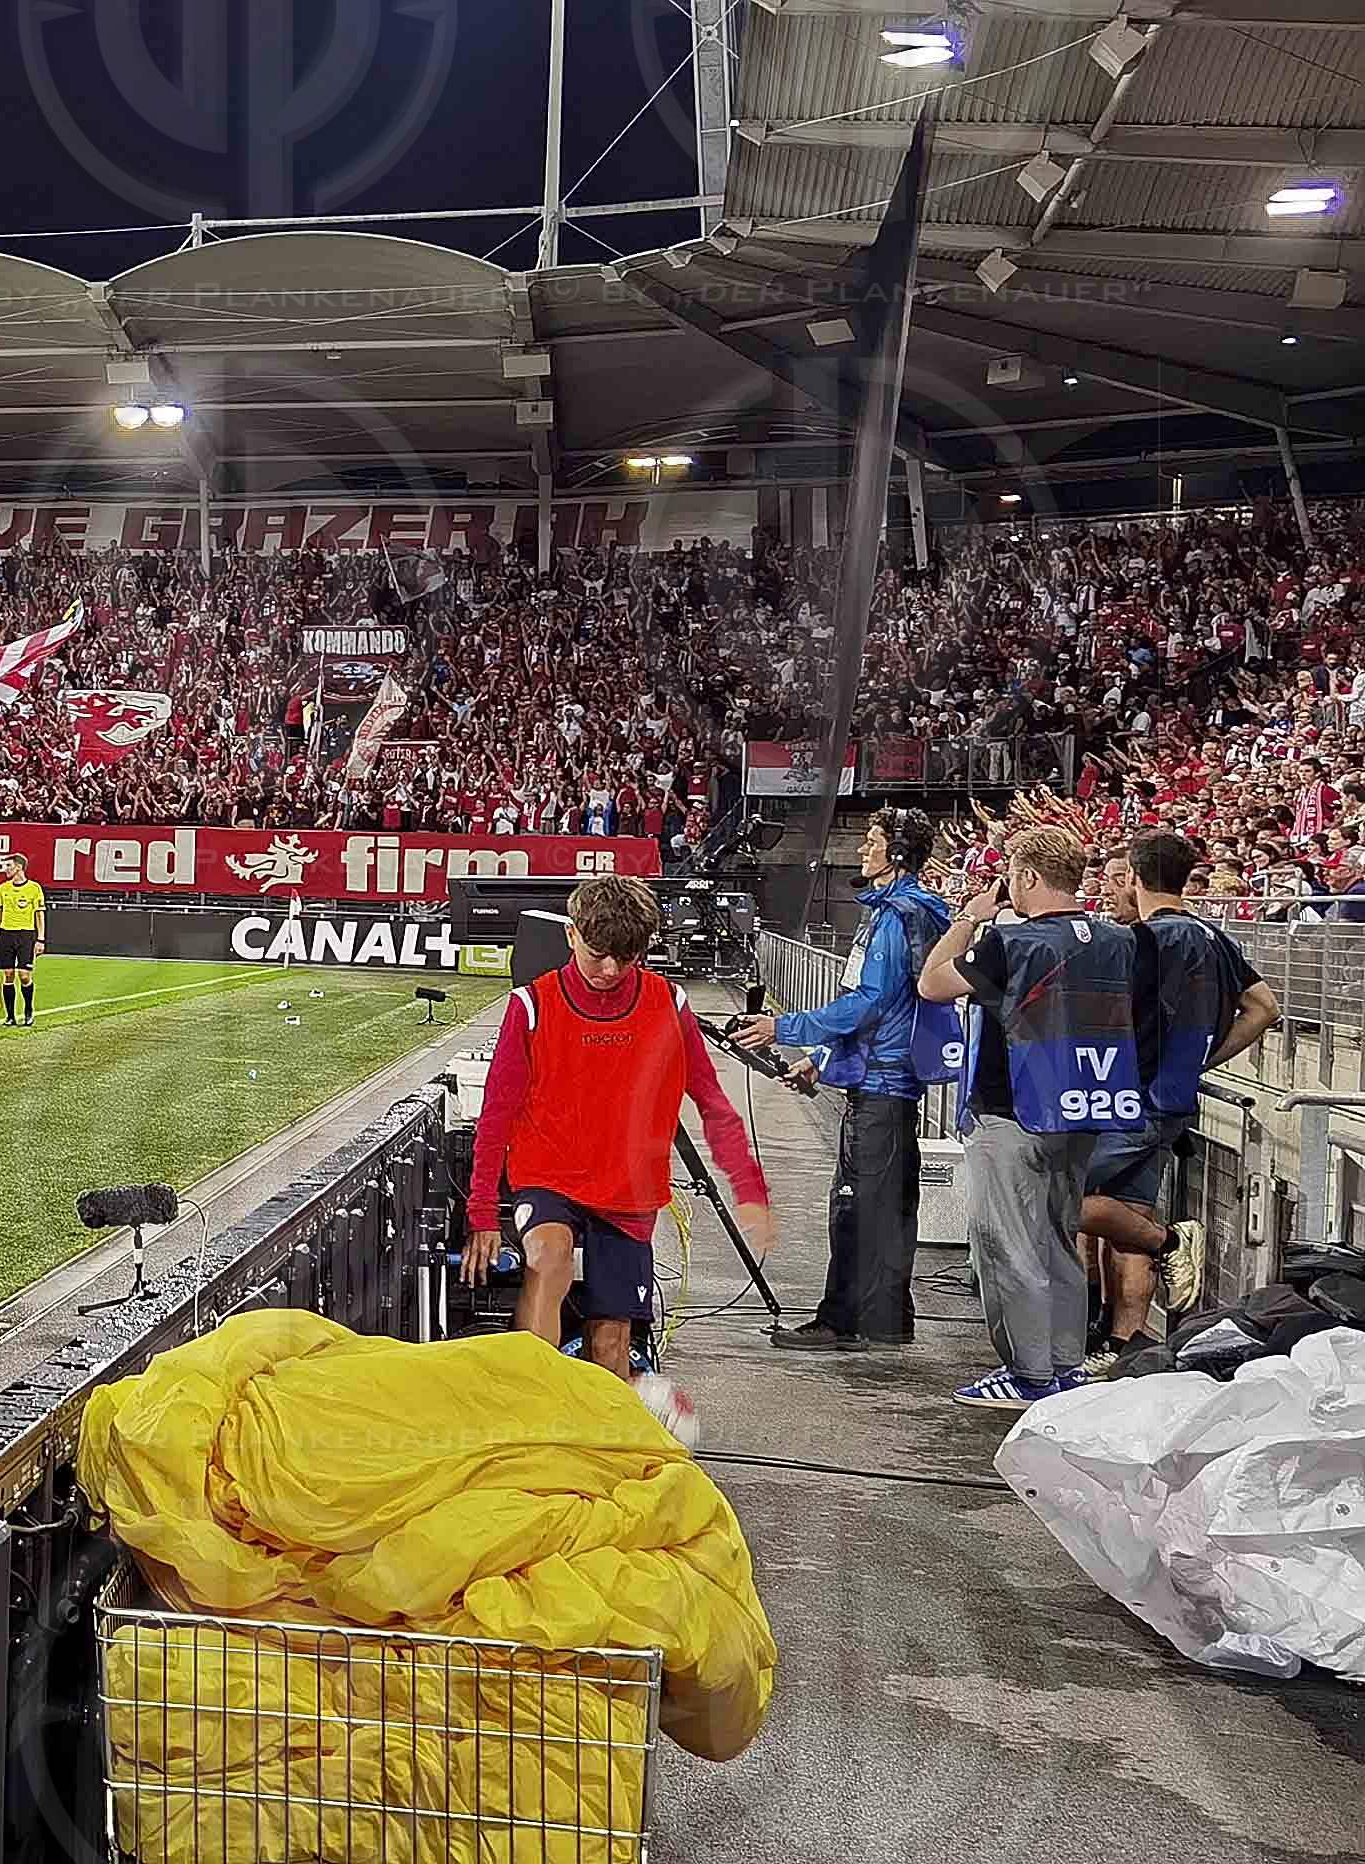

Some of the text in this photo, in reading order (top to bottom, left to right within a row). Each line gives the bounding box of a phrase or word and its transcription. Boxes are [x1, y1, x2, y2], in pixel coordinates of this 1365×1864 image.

[121, 503, 497, 551] GRAZER
[302, 630, 406, 655] KOMMANDO
[54, 829, 530, 895] red firm
[576, 850, 615, 872] GR
[231, 916, 458, 968] CANAL+
[1076, 1047, 1118, 1081] TV
[1060, 1089, 1142, 1120] 926
